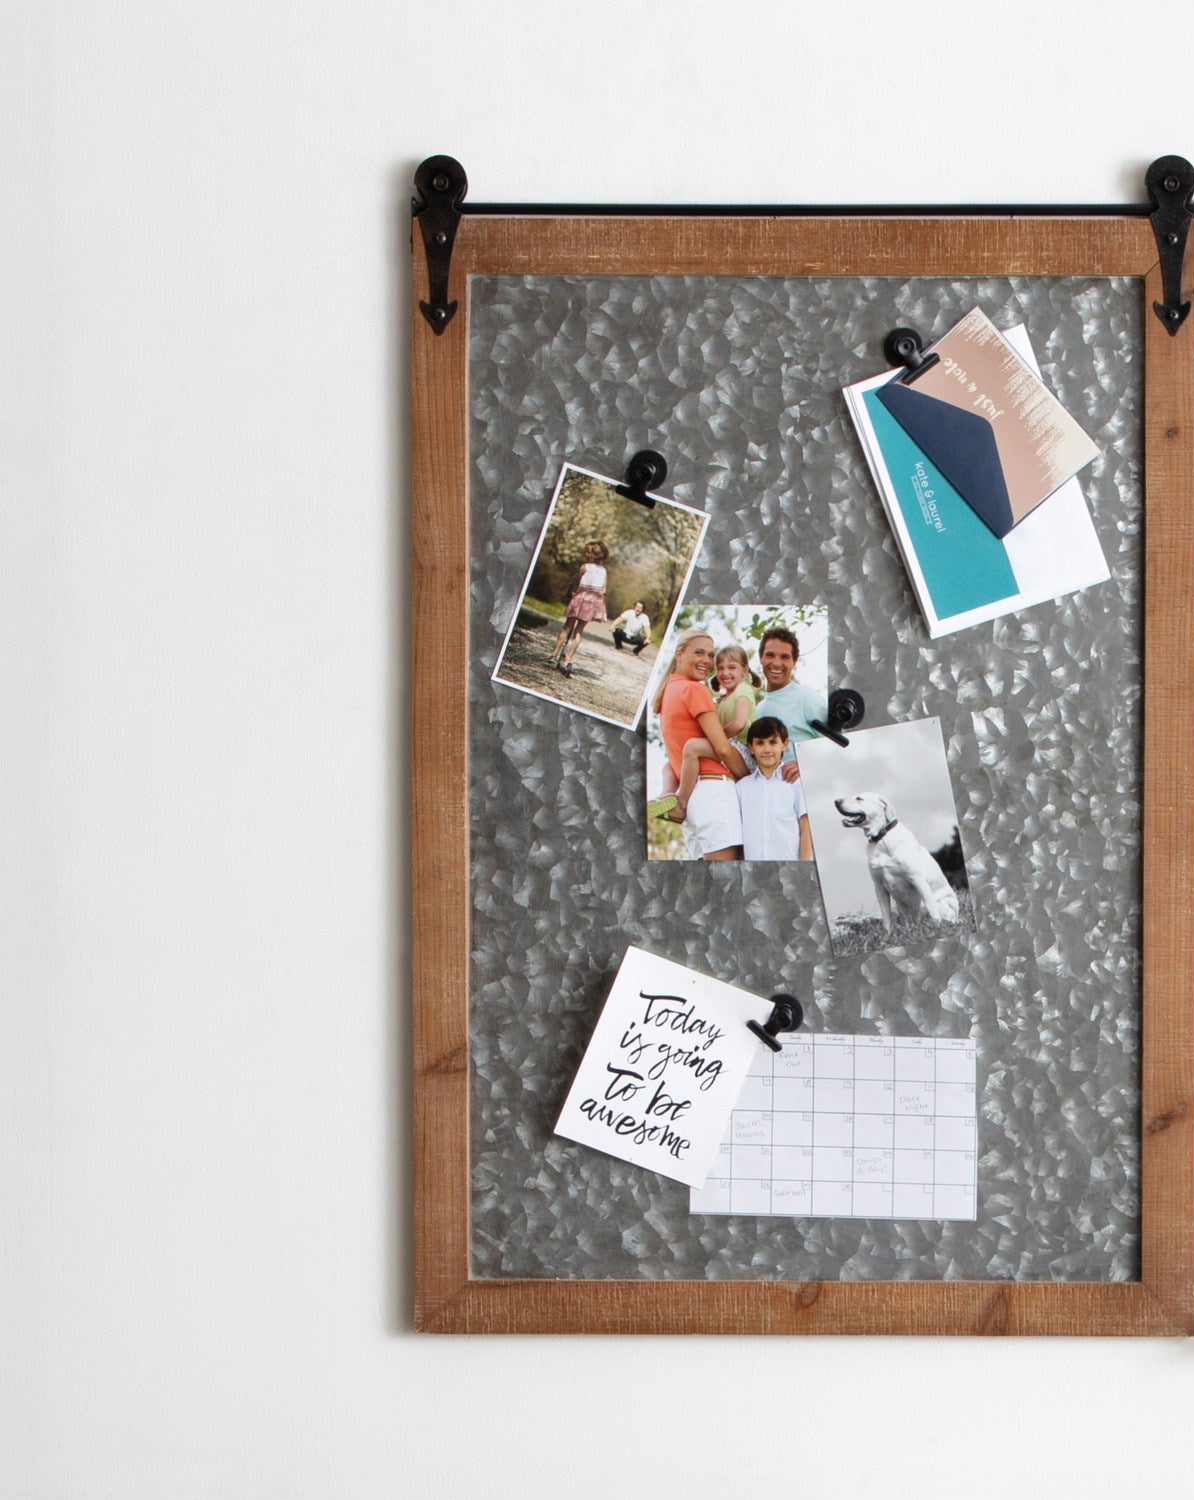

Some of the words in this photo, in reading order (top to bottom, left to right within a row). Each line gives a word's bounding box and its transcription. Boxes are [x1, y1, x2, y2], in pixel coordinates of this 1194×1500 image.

[915, 461, 929, 488] kate
[923, 489, 935, 498] &
[927, 499, 946, 533] laurel
[639, 990, 725, 1051] Today
[620, 1021, 654, 1065] is
[648, 1043, 729, 1092] going
[645, 1080, 692, 1121] be
[579, 1097, 690, 1160] awesome
